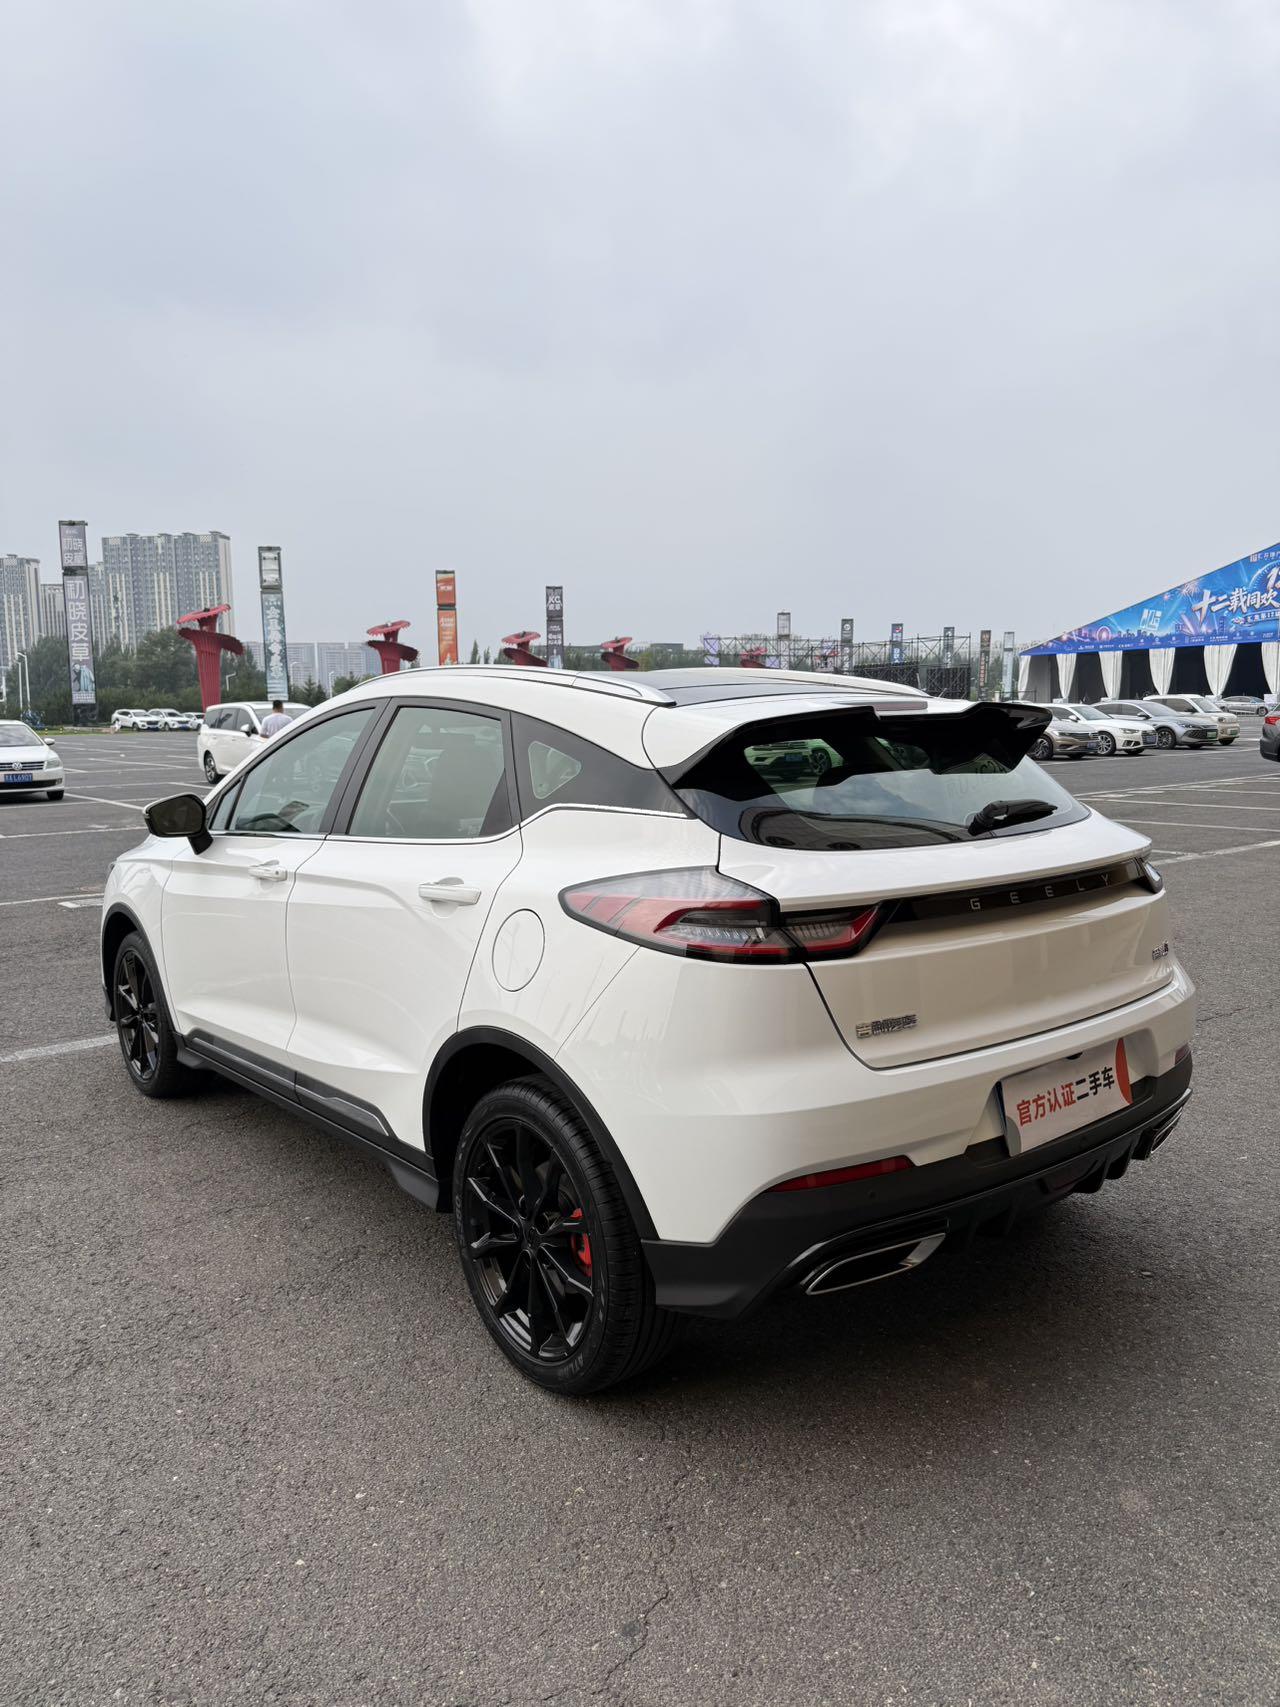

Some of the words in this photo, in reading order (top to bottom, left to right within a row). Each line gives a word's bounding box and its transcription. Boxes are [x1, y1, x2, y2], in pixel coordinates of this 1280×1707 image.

[65, 580, 90, 661] 初晓皮草
[970, 874, 1110, 910] GEELY
[1016, 1066, 1115, 1126] 官方认证二手车
